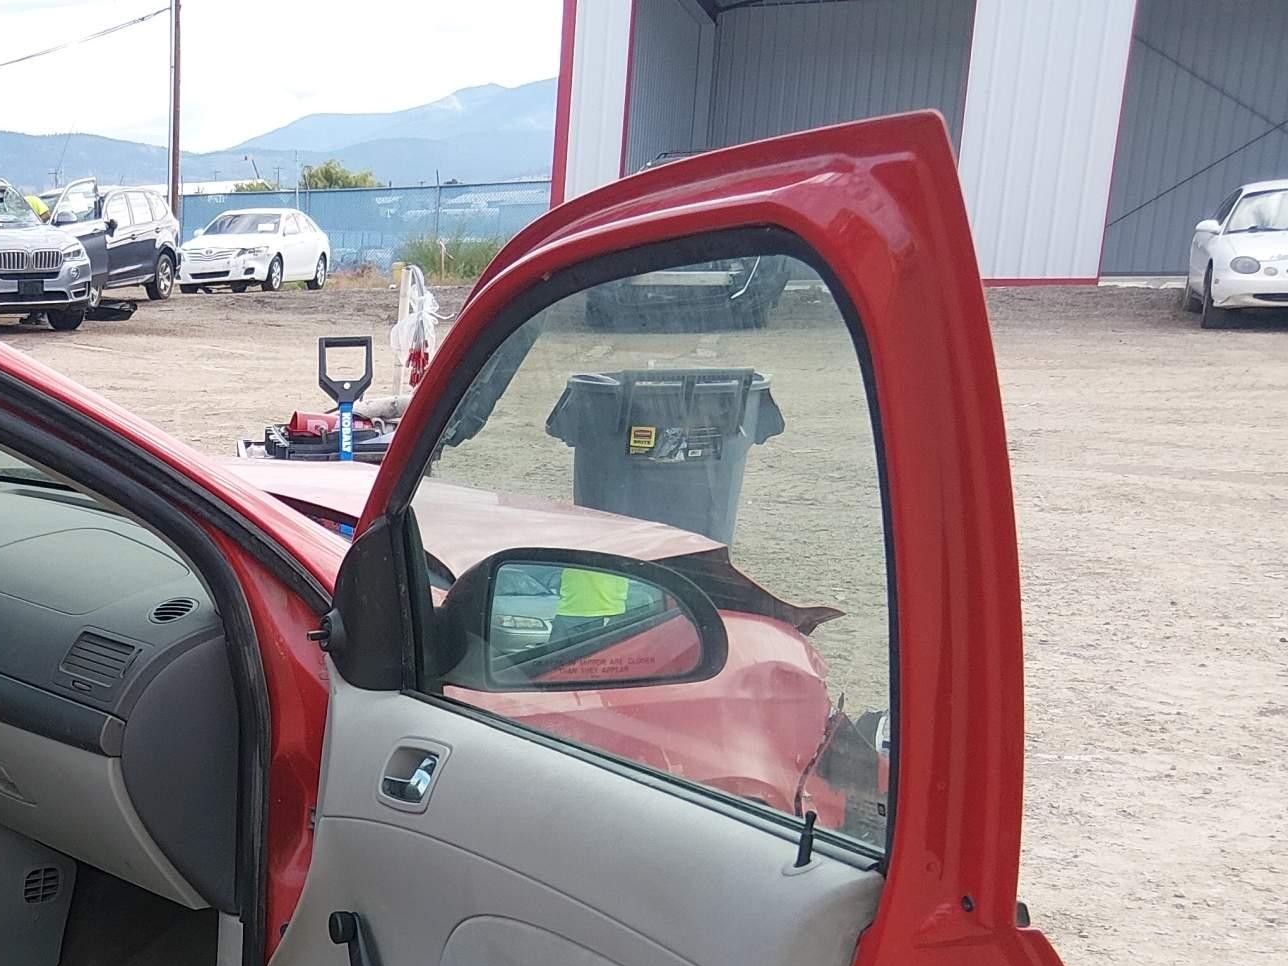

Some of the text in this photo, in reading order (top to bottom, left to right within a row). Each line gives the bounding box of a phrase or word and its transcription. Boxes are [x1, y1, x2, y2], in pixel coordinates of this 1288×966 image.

[341, 412, 353, 453] KOBALT
[580, 666, 599, 674] THEY
[601, 665, 630, 673] APPEAR
